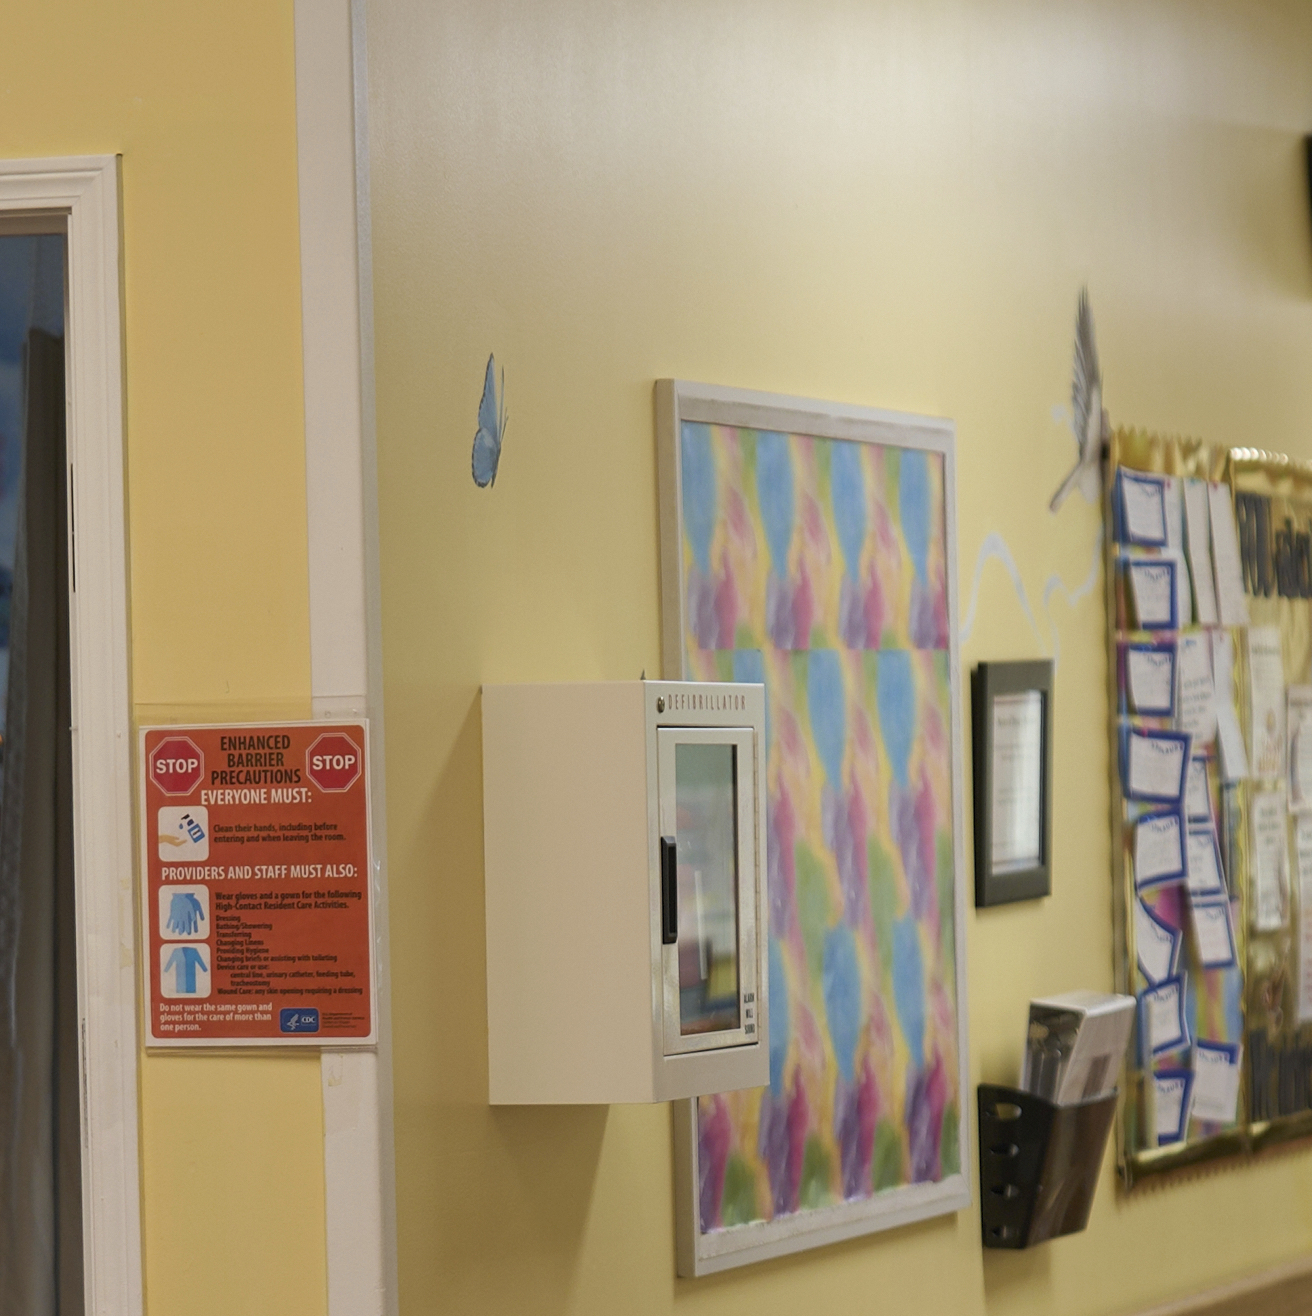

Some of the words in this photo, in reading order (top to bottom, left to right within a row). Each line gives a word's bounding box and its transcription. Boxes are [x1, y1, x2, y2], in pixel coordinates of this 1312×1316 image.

[668, 694, 746, 710] DEFIBRILLATOR
[220, 735, 291, 751] ENHANCED
[156, 758, 198, 774] STOP
[227, 752, 284, 768] BARRIER
[312, 755, 356, 770] STOP
[211, 769, 301, 785] PRECAUTIONS
[201, 789, 267, 805] EVERYONE
[271, 787, 312, 803] MUST:
[213, 824, 233, 833] Clean
[235, 824, 252, 832] their
[254, 824, 277, 833] hands,
[279, 823, 312, 833] including
[314, 822, 338, 831] before
[214, 835, 244, 844] entering
[246, 834, 260, 842] and
[261, 834, 281, 842] when
[283, 834, 309, 843] leaving
[311, 833, 323, 841] the
[161, 866, 225, 880] PROVIDERS
[227, 866, 252, 879] AND
[254, 865, 287, 879] STAFF
[290, 864, 322, 878] MUST
[325, 864, 358, 877] ALSO:
[215, 892, 233, 900] Wear
[235, 892, 257, 901] gloves
[259, 891, 273, 899] and
[280, 892, 301, 901] gown
[302, 891, 312, 899] for
[314, 891, 326, 899] the
[327, 890, 362, 900] following
[215, 902, 262, 912] High-Contact
[264, 901, 295, 910] Resident
[296, 901, 312, 909] Care
[314, 900, 349, 909] Activities.
[159, 1003, 169, 1012] Do
[203, 1003, 215, 1011] the
[237, 1004, 257, 1013] gown
[259, 1002, 272, 1011] and
[160, 1013, 183, 1023] gloves
[184, 1013, 194, 1021] for
[195, 1012, 207, 1021] the
[209, 1013, 224, 1021] care
[225, 1012, 234, 1020] of
[254, 1012, 272, 1020] than
[175, 1024, 201, 1033] person.
